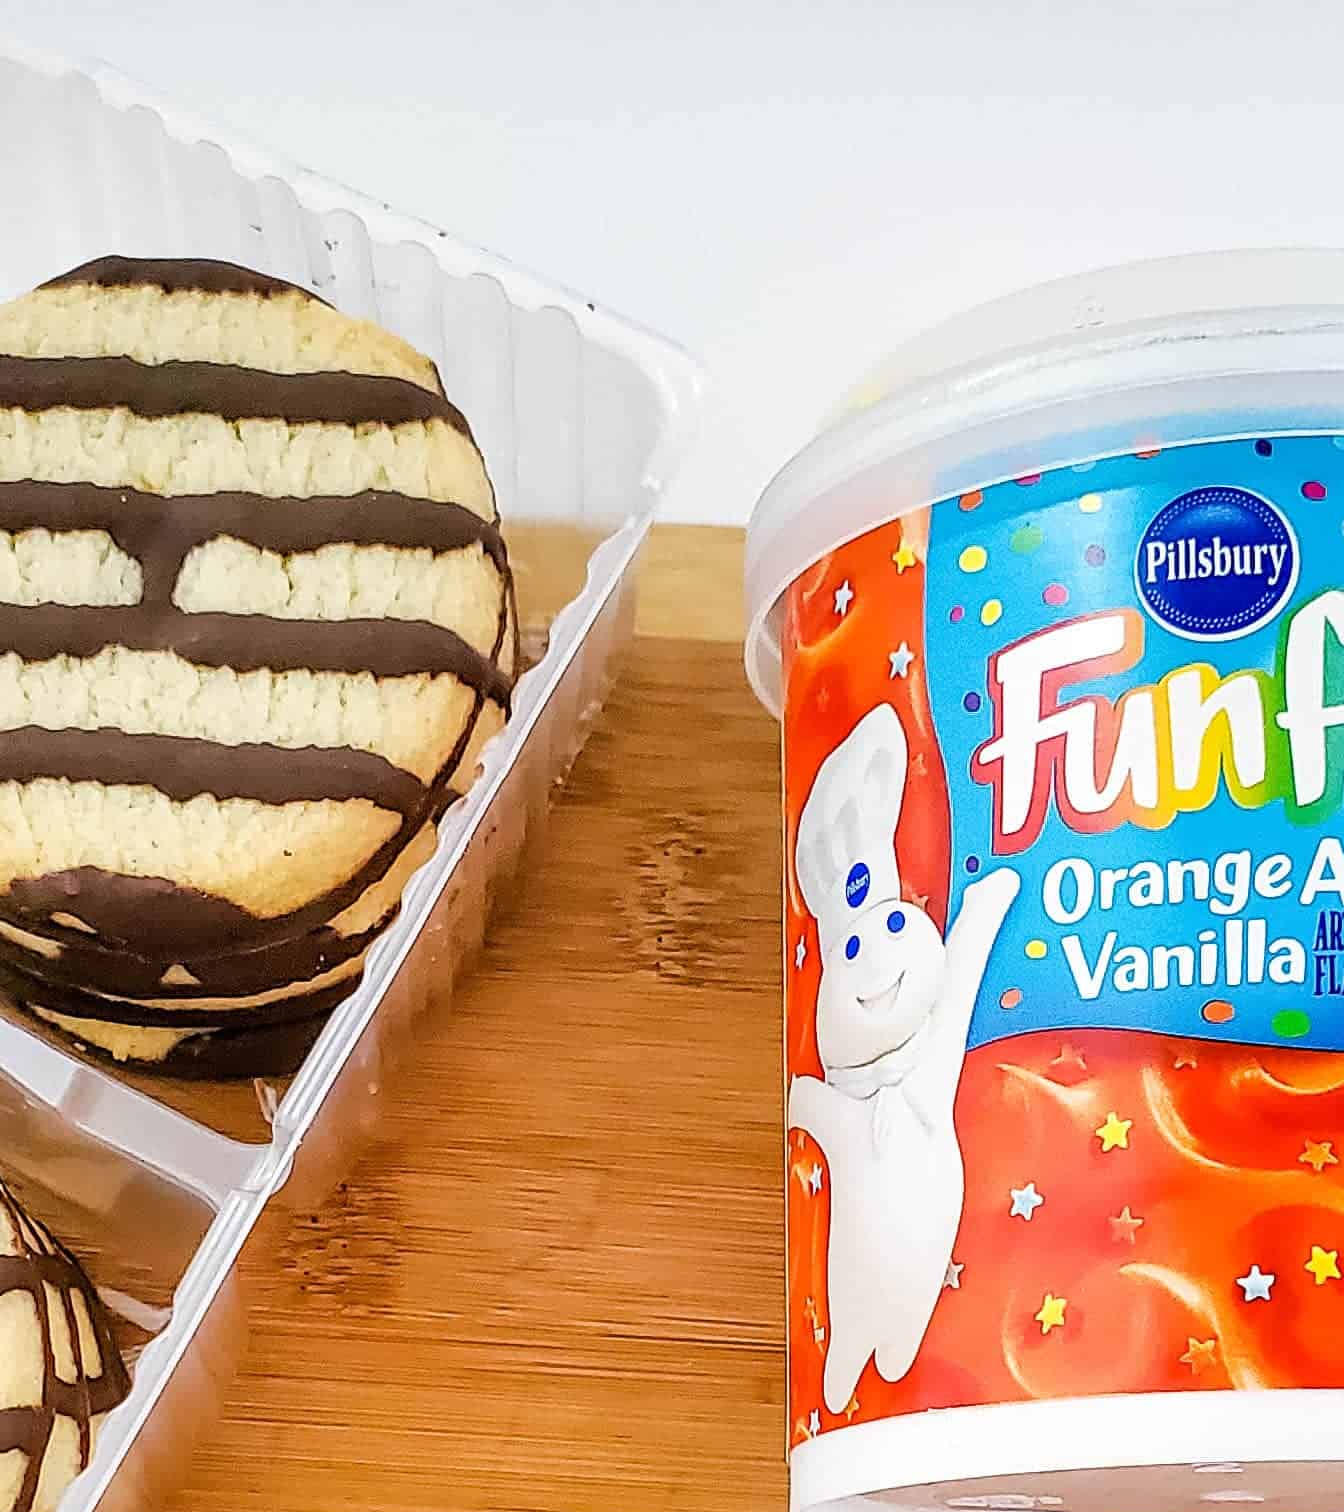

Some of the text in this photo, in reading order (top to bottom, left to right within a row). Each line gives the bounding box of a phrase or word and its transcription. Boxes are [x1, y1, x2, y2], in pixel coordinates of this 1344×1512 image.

[1145, 535, 1289, 587] Pillsbury
[1042, 849, 1294, 926] Orange
[1060, 917, 1307, 1001] Vanilla
